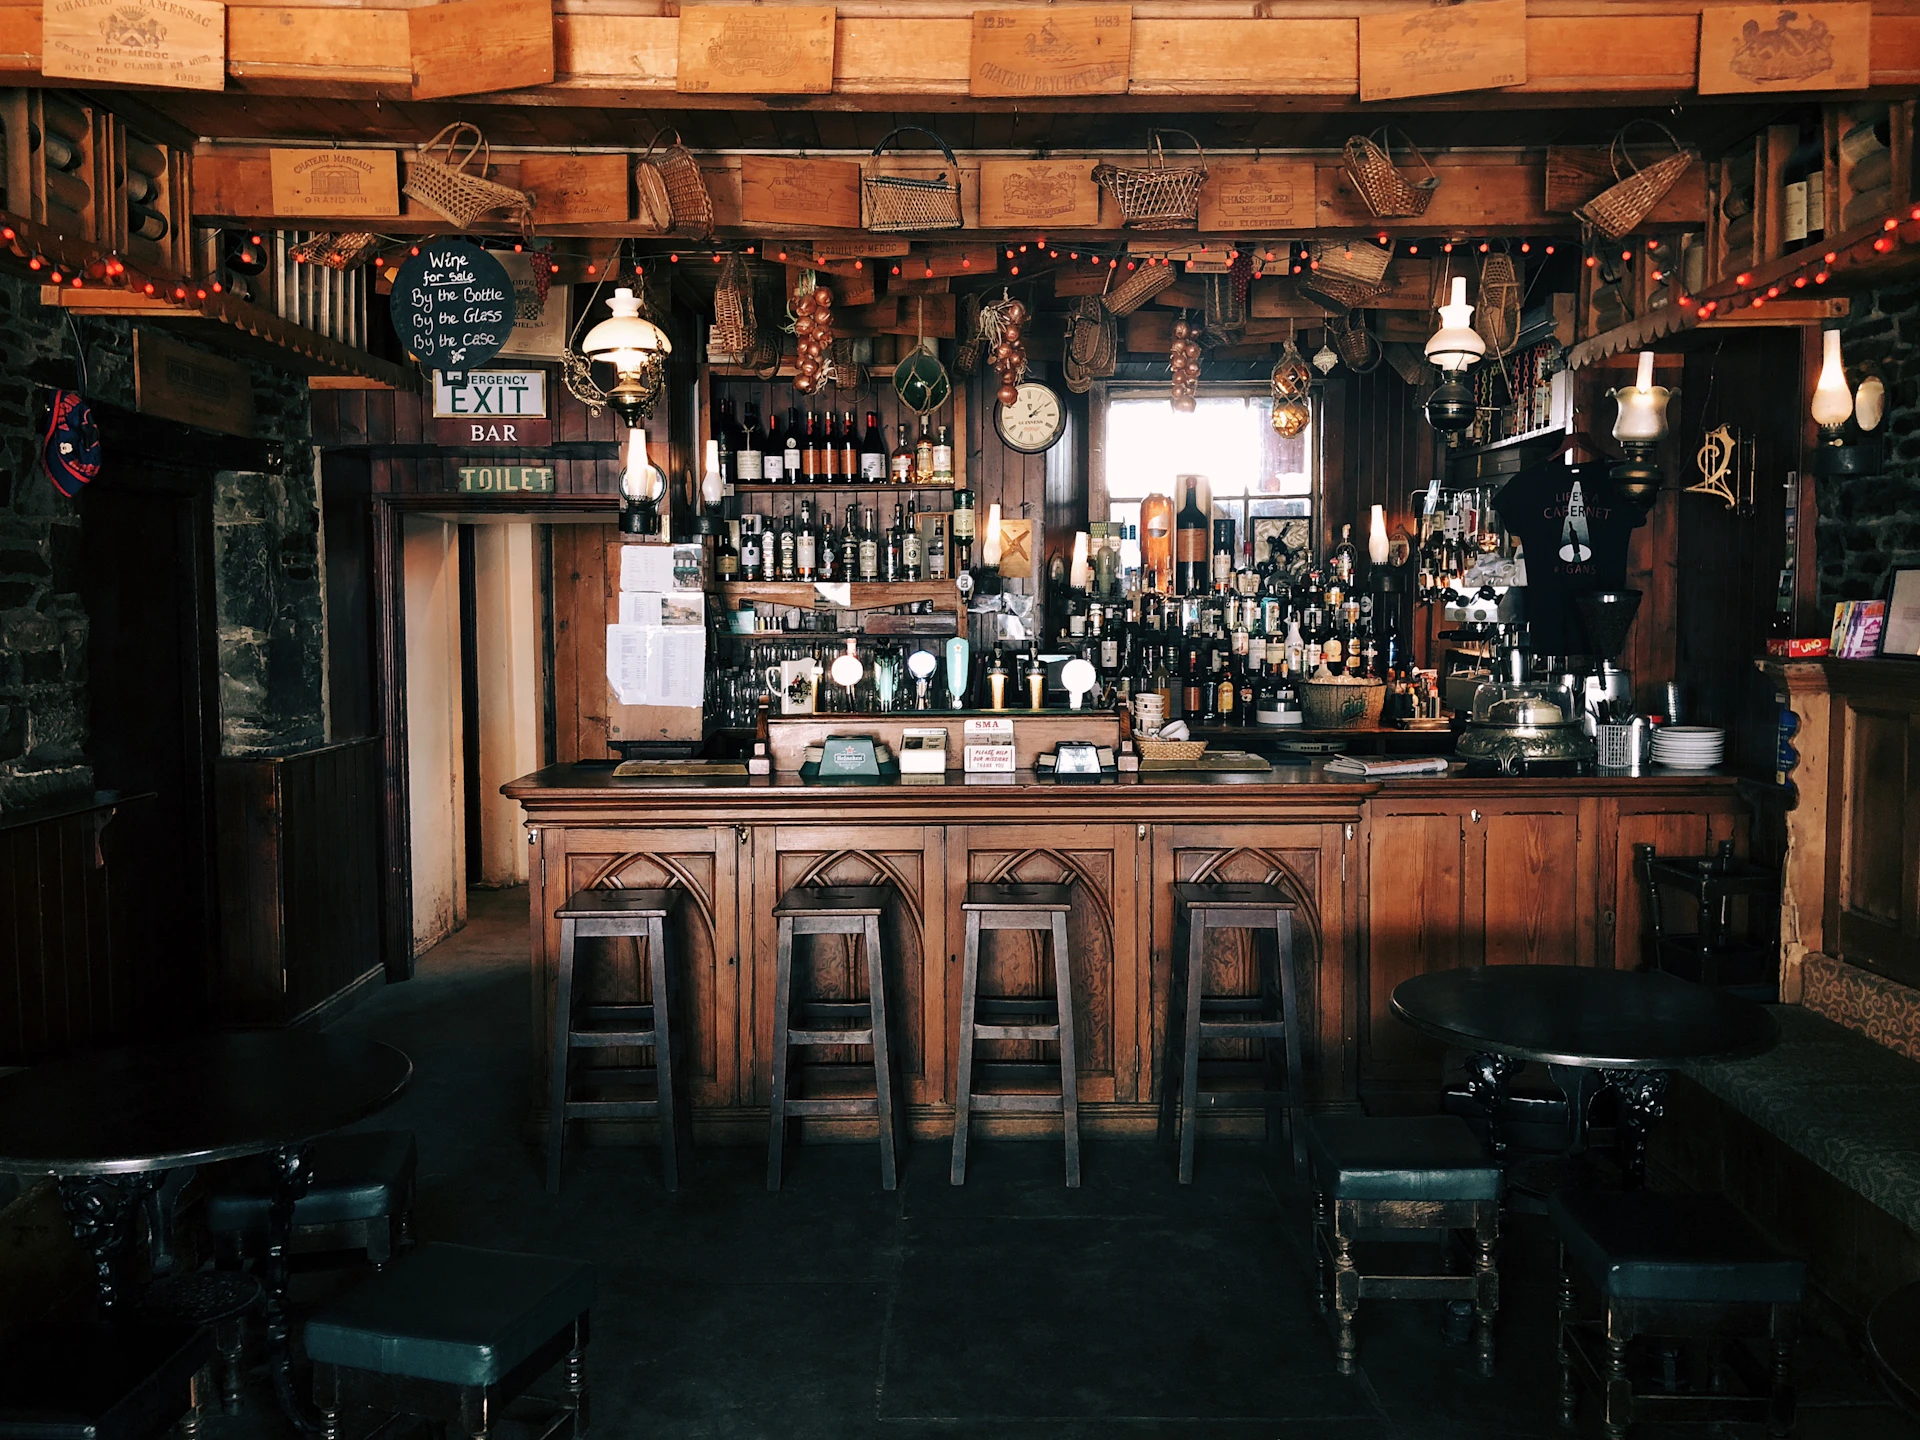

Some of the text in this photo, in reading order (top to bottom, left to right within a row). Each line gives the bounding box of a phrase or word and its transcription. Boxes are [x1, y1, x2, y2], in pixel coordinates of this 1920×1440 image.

[96, 46, 169, 60] HAUT-MÉDOC
[96, 56, 118, 67] CRU
[979, 62, 1030, 91] CHATEAU
[293, 154, 376, 175] CHATEAU MARGAUX
[304, 196, 368, 205] GRAND VIN
[867, 243, 897, 253] MEDOC
[429, 252, 469, 271] Wine
[423, 270, 476, 287] for sale
[411, 287, 505, 313] By the Bottle
[413, 308, 502, 335] By the Glass
[413, 333, 499, 356] By the Case
[453, 375, 527, 385] ERGENCY
[451, 386, 529, 413] EXIT
[471, 424, 517, 442] BAR
[461, 468, 551, 491] TOILET
[1555, 492, 1588, 502] LIFE'S
[1543, 505, 1612, 520] CABERNET
[1800, 639, 1822, 653] UNO
